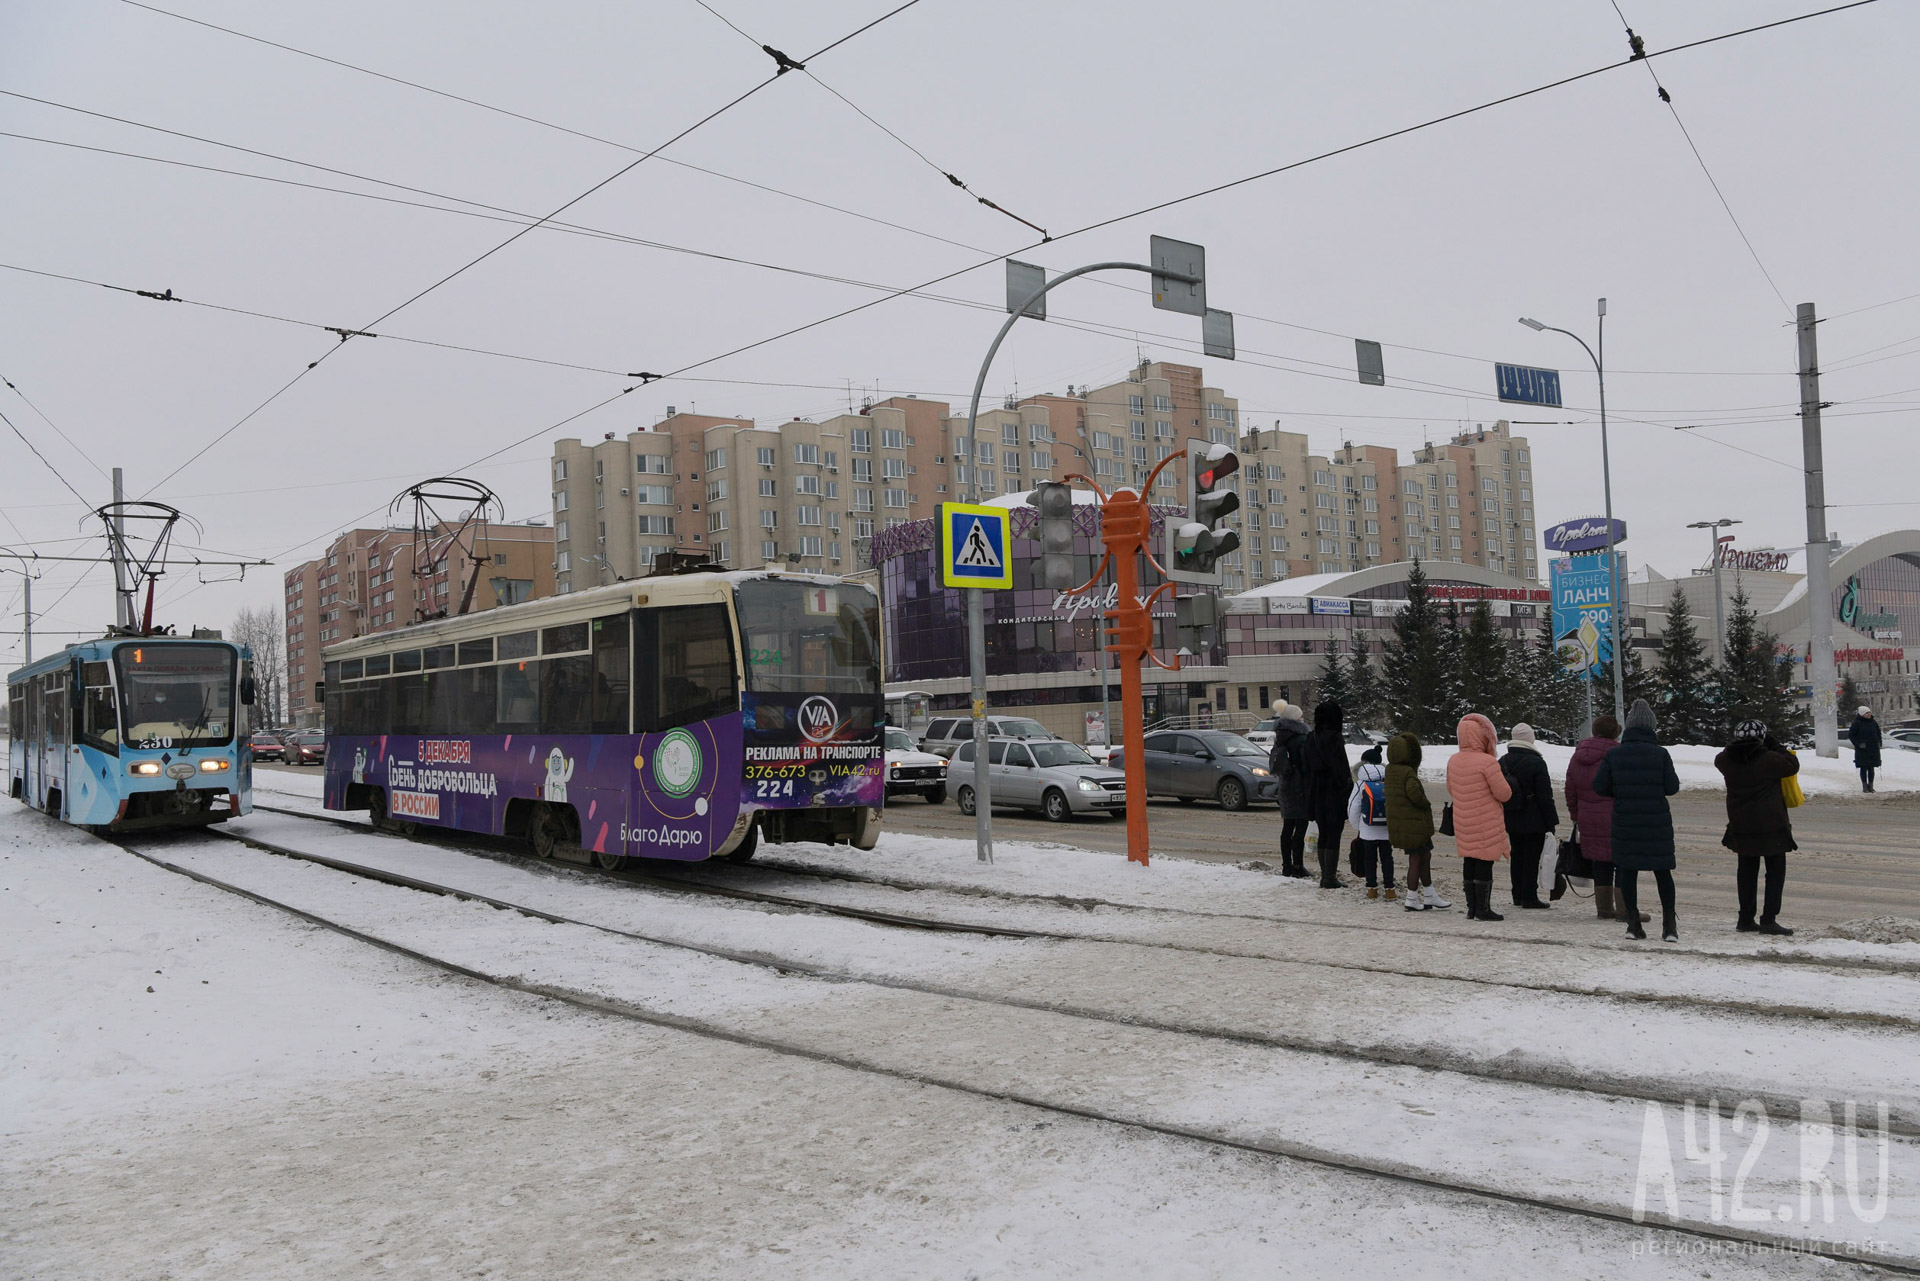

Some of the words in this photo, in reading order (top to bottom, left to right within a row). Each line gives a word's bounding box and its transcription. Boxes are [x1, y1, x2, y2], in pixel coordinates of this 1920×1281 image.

[1561, 574, 1609, 588] БИЗНЕС
[815, 589, 826, 612] 1
[1562, 587, 1610, 604] ЛАНЧ
[1319, 600, 1349, 609] АВИАКАССА
[998, 615, 1065, 624] КОНДИТЕРСКАЯ
[133, 649, 143, 663] 1
[750, 648, 782, 665] 224
[805, 705, 832, 726] VIA
[138, 736, 173, 749] 230
[418, 740, 425, 762] 5
[425, 740, 471, 765] ДЕКАБРЯ
[745, 746, 800, 760] РЕКЛАМА
[803, 746, 817, 759] НА
[820, 746, 881, 759] ТРАНСПОРТЕ
[745, 765, 806, 778] 376-673
[829, 764, 880, 777] VIA42.ru
[417, 769, 498, 799] ДОБРОВОЛЬЦА
[757, 780, 793, 797] 224
[393, 793, 399, 812] В
[401, 793, 439, 817] РОССИИ
